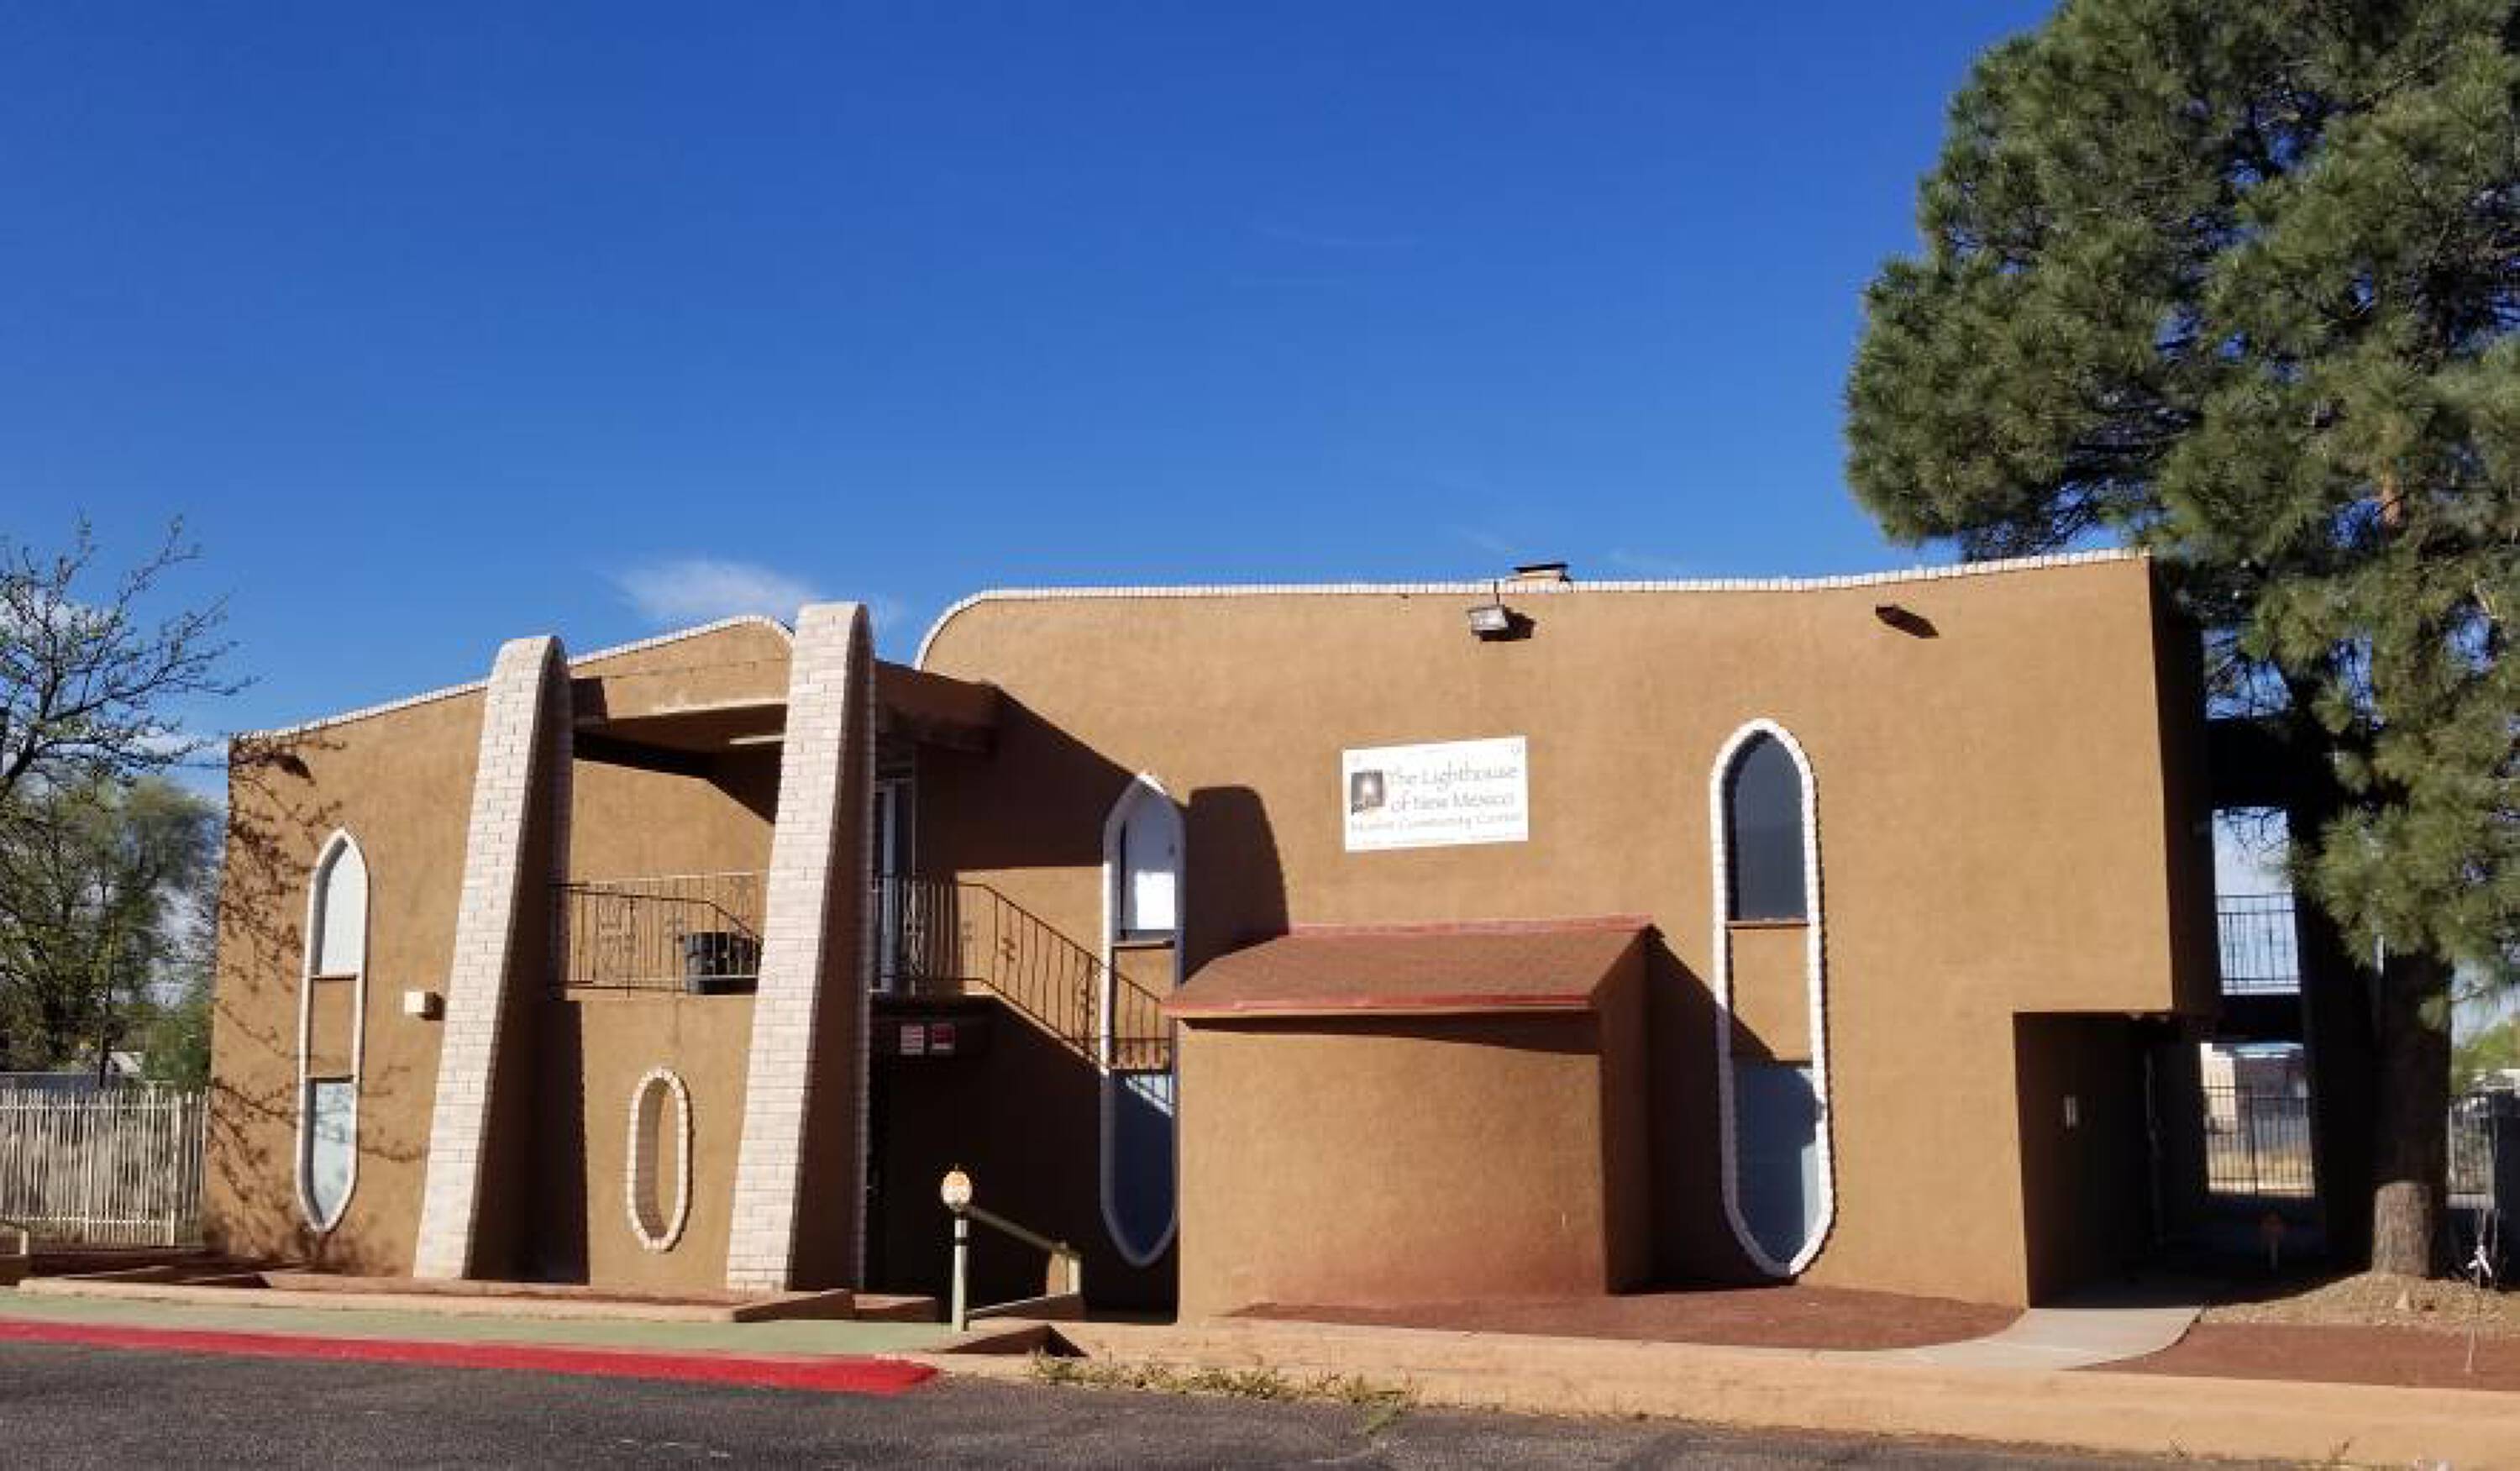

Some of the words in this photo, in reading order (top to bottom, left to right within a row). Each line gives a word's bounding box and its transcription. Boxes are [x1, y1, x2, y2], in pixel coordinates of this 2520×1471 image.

[1387, 766, 1418, 785] The
[1421, 756, 1518, 792] Lighthouse
[1391, 790, 1411, 812] of
[1414, 795, 1449, 810] New
[1453, 791, 1515, 808] Mexico
